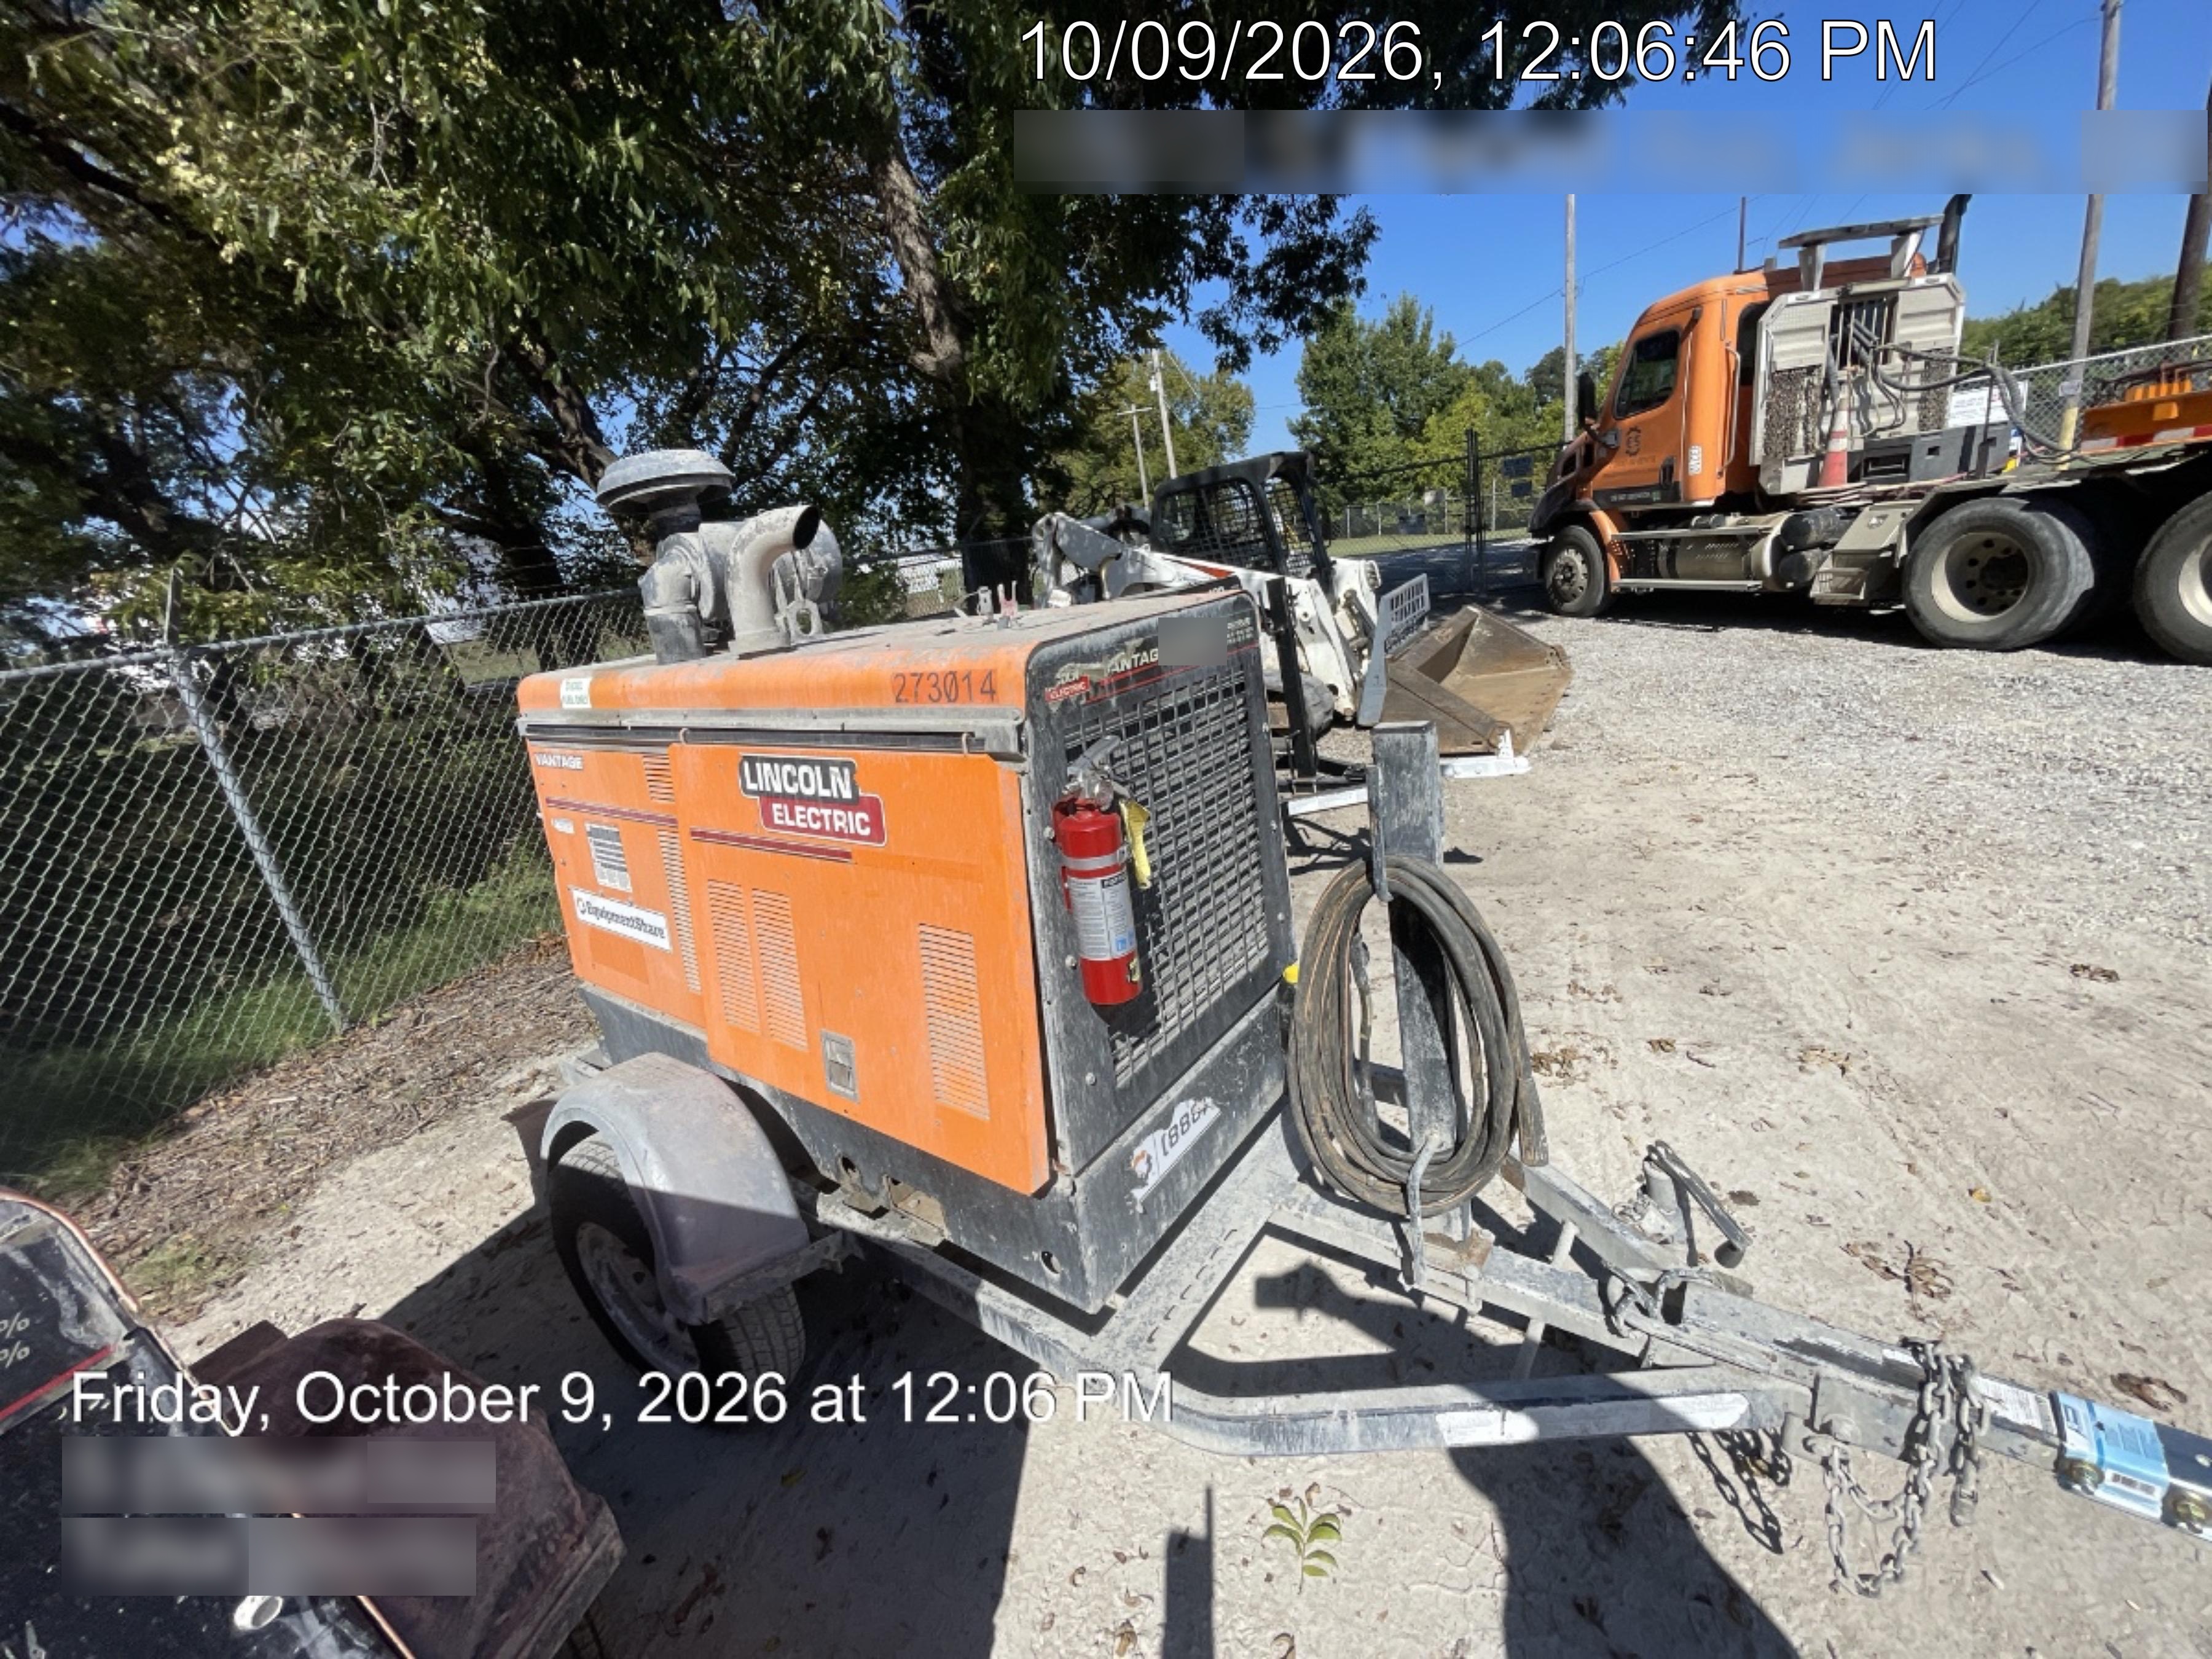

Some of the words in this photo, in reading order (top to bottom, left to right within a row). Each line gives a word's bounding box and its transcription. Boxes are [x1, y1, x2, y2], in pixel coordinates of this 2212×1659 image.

[893, 669, 996, 703] 273014
[534, 753, 583, 770] VANTAGE
[743, 760, 853, 799] LINCOLN
[771, 802, 871, 836] ELECTRIC
